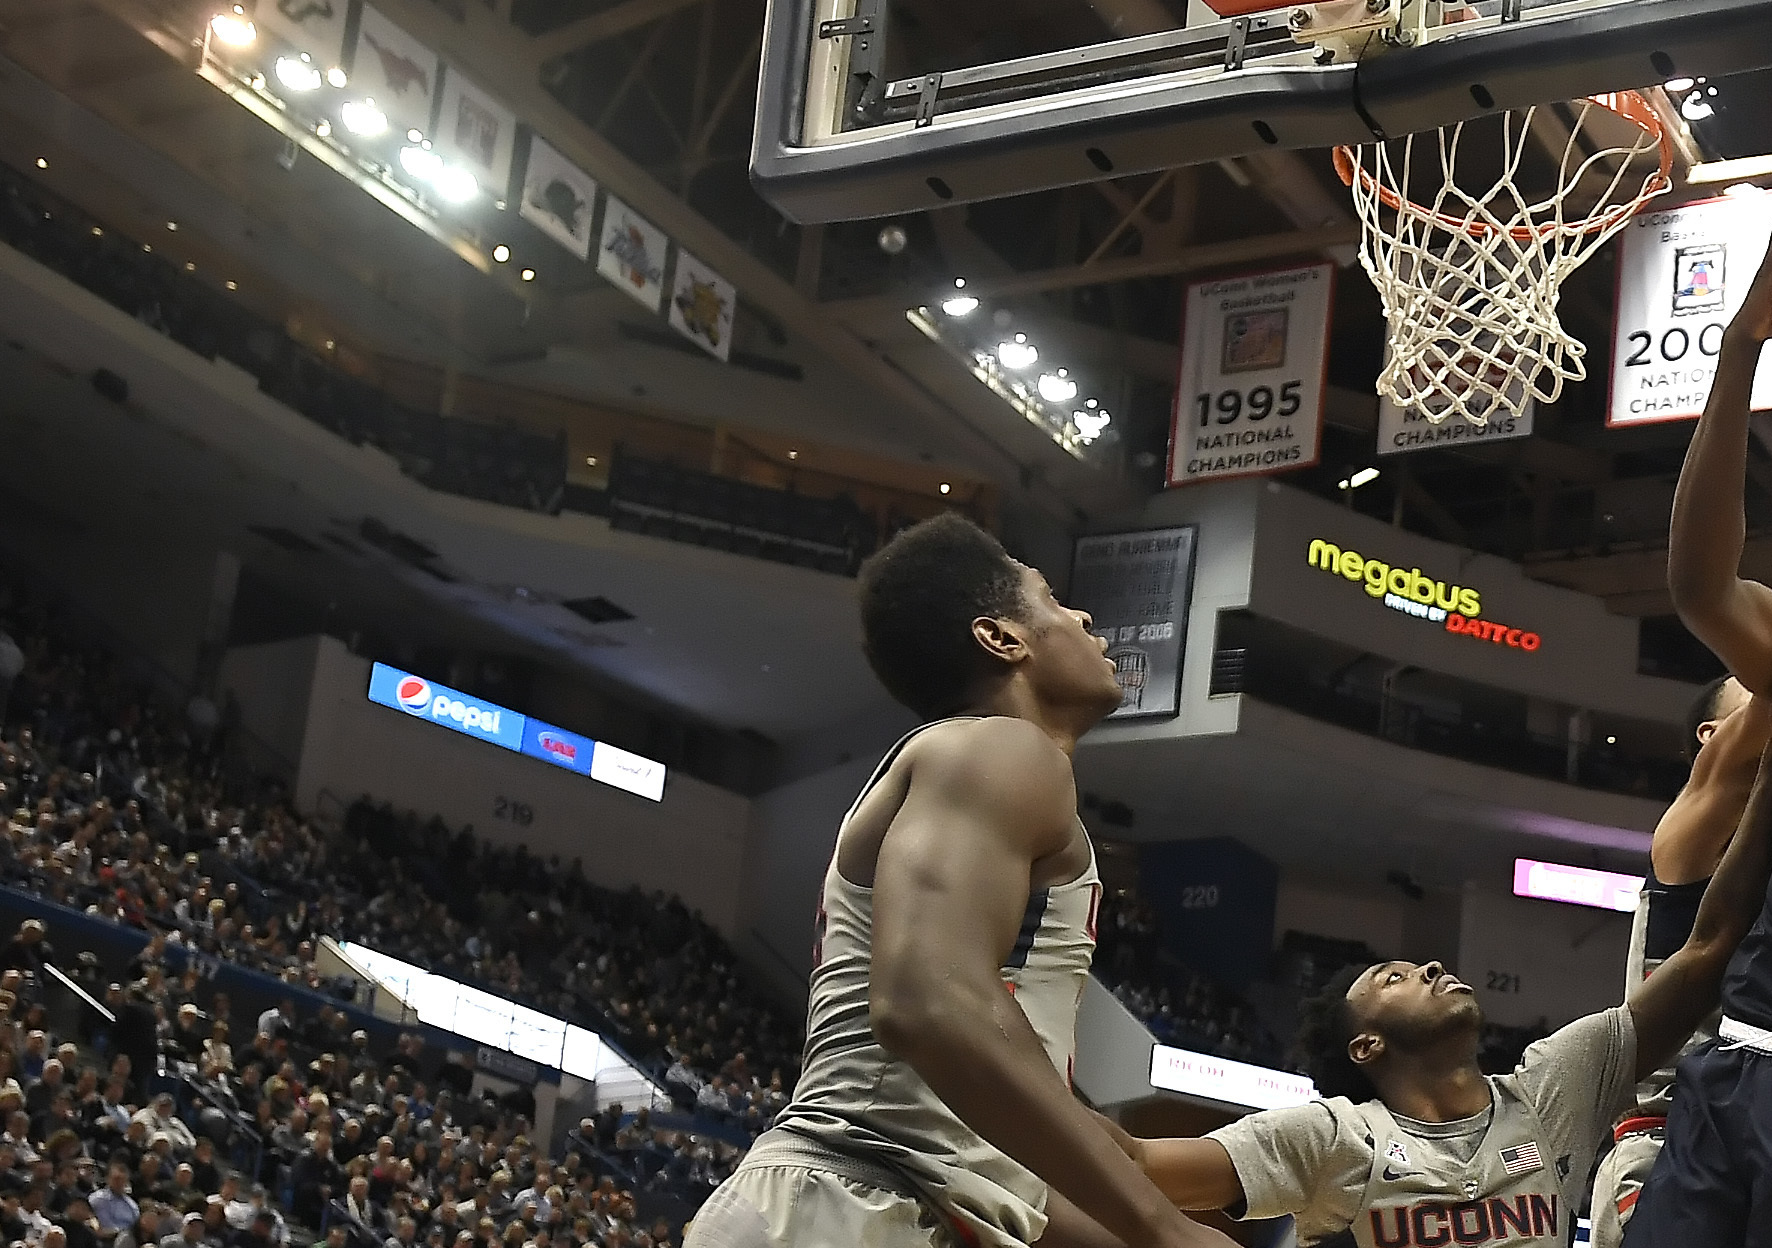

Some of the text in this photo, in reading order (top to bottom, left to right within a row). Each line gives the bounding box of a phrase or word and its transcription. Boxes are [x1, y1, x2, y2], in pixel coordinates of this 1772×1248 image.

[1624, 322, 1726, 367] 200
[1640, 368, 1718, 389] NATIO
[1196, 379, 1302, 427] 1995
[1629, 391, 1706, 414] CHAMP
[1195, 425, 1295, 451] NATIONAL
[1393, 418, 1517, 448] CHAMPIONS
[1186, 445, 1302, 475] CHAMPIONS
[1307, 538, 1482, 617] megabus
[1445, 613, 1542, 652] DATTCO
[431, 694, 500, 734] pepsi
[1487, 970, 1521, 993] 221
